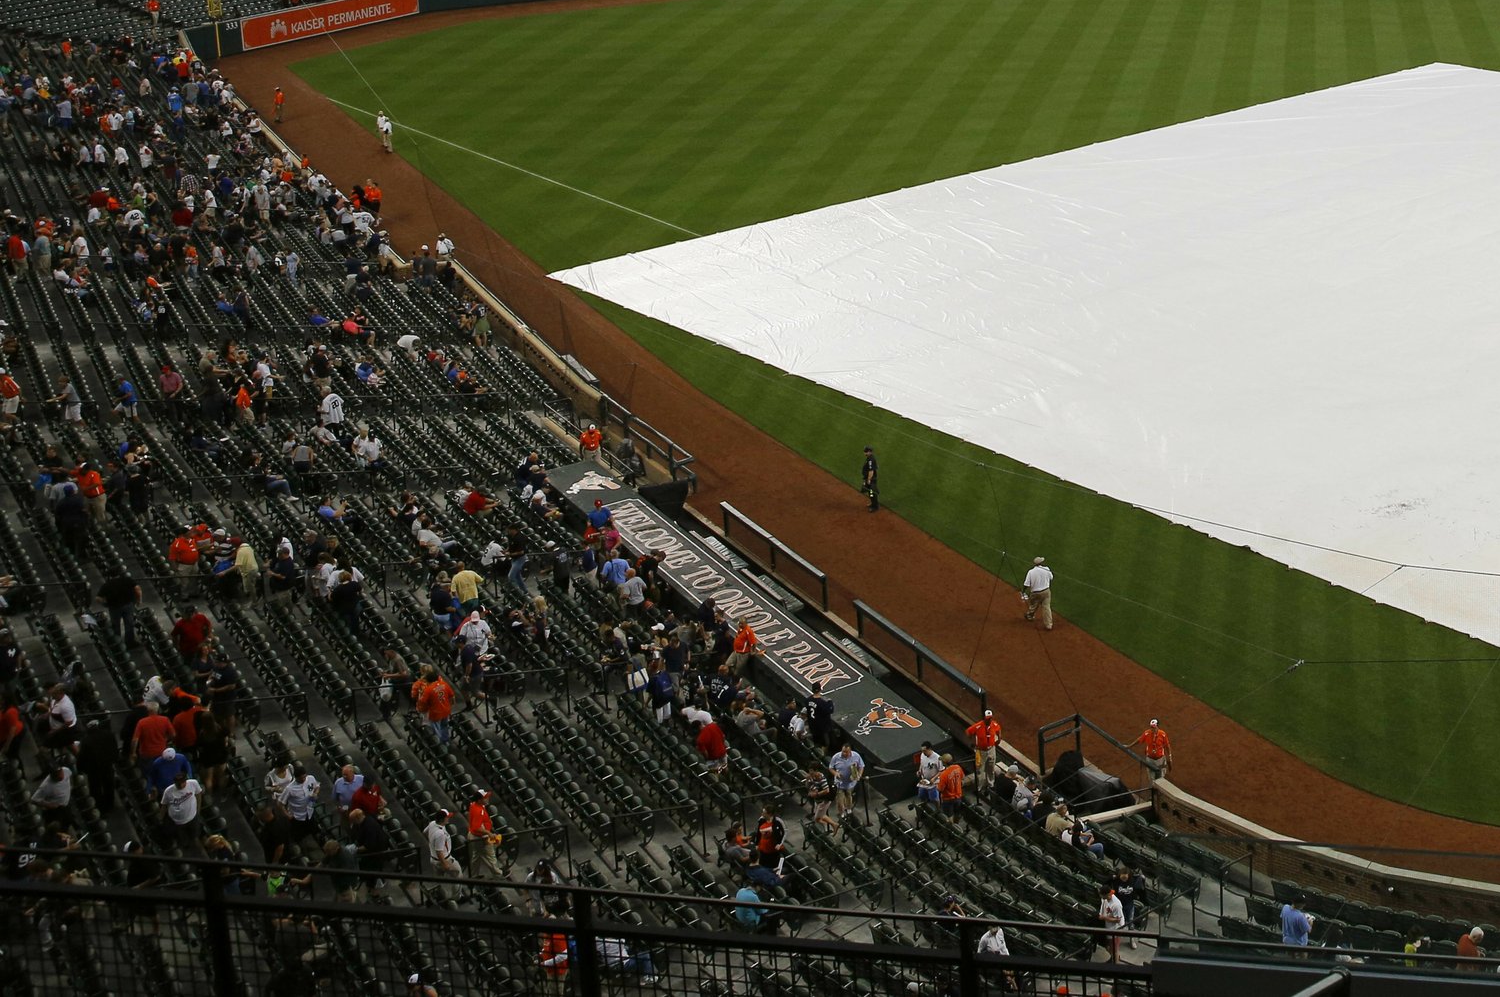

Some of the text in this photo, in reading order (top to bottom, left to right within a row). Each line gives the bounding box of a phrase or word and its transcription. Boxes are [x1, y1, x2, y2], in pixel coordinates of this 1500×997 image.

[226, 22, 238, 30] 333
[291, 3, 391, 34] KAISER PERMANENTE
[609, 502, 851, 690] WELCOME TO ORIOLE PARK
